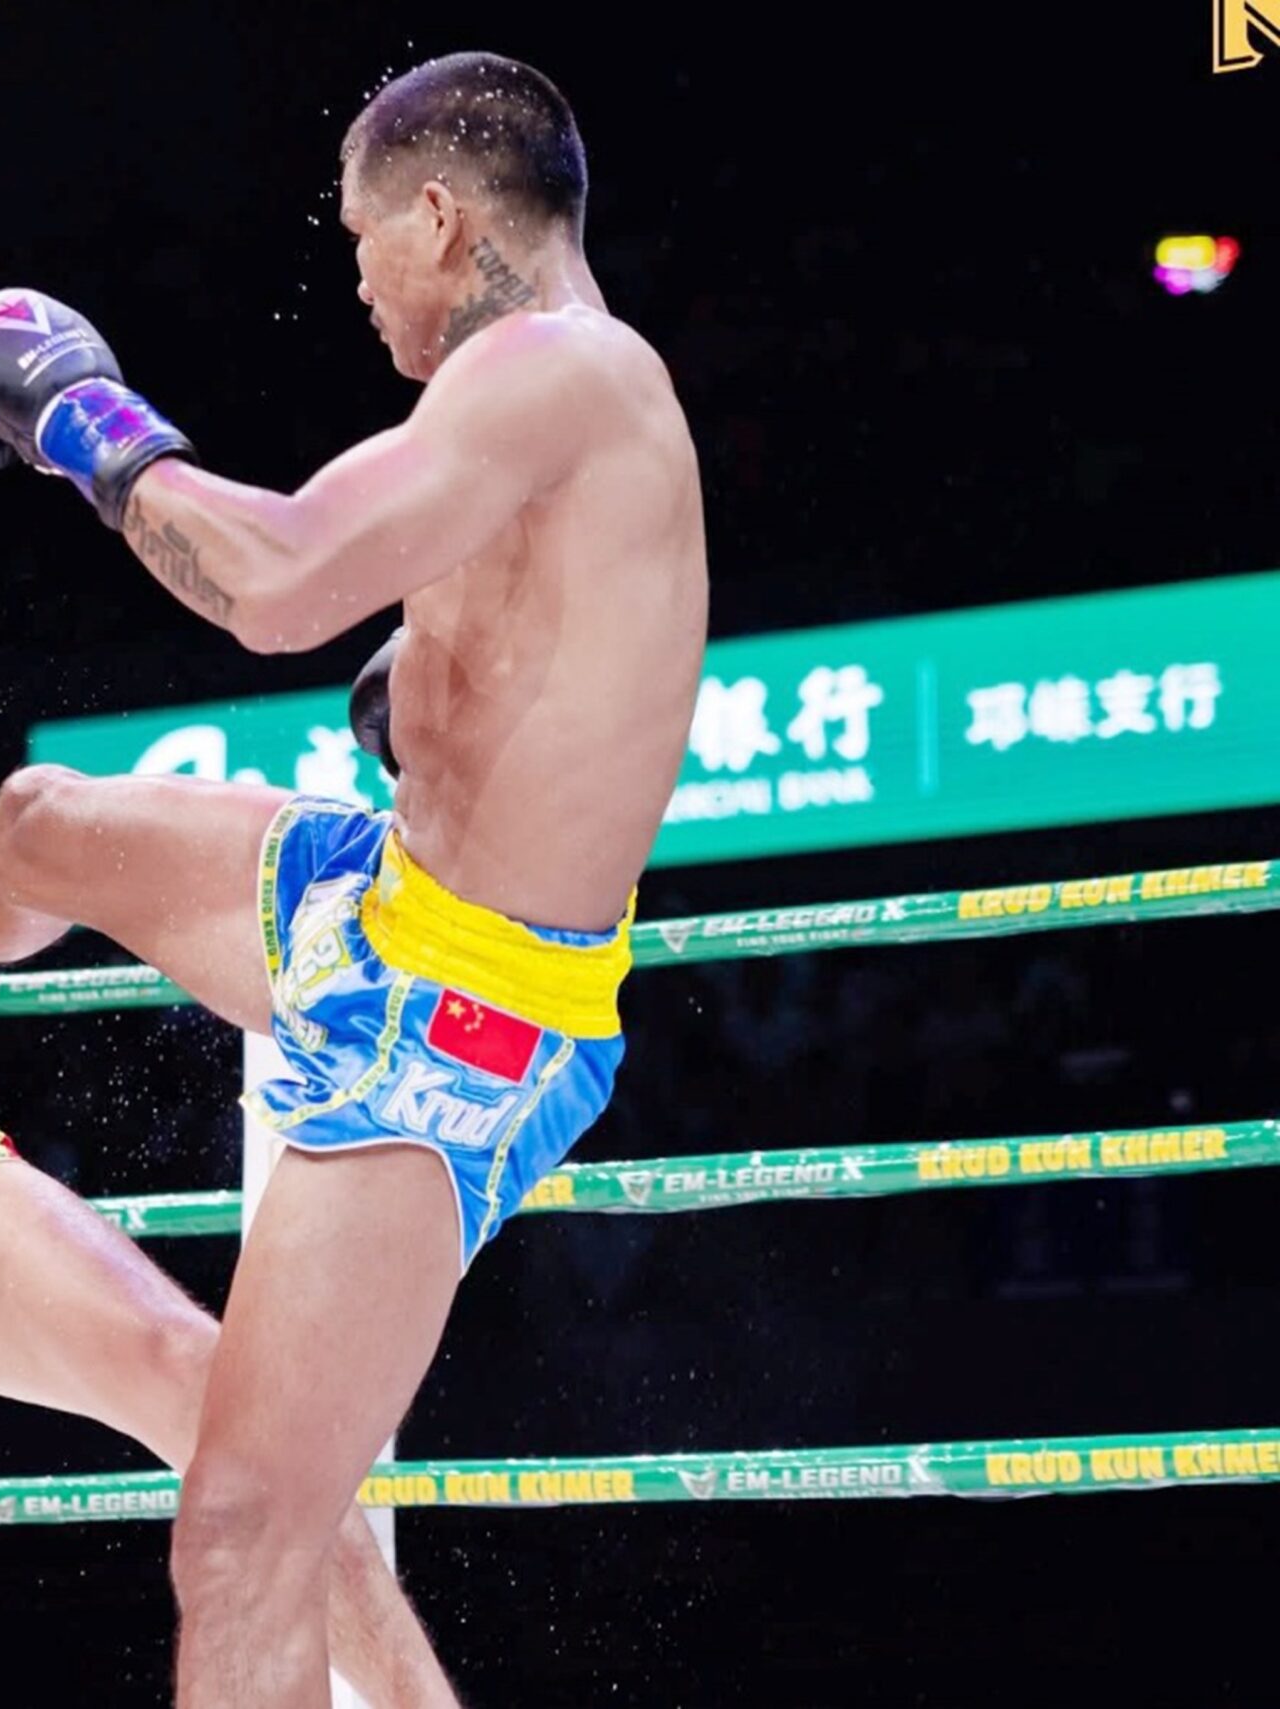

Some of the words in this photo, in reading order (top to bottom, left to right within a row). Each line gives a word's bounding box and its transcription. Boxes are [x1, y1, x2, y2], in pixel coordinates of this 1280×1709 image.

[958, 884, 1052, 919] KRUD
[1060, 876, 1133, 909] KUN
[1141, 862, 1269, 900] KHMER
[380, 1061, 520, 1147] Krud
[918, 1147, 1011, 1180] KRUD
[1019, 1140, 1092, 1174] KUN
[1100, 1129, 1229, 1167] KHMER
[664, 1162, 836, 1194] EM-LEGEND
[727, 1464, 902, 1491] EM-LEGEND
[986, 1452, 1082, 1485] KRUD
[1090, 1447, 1167, 1480] KUN
[445, 1472, 511, 1502] KUN
[518, 1469, 636, 1502] KHMER
